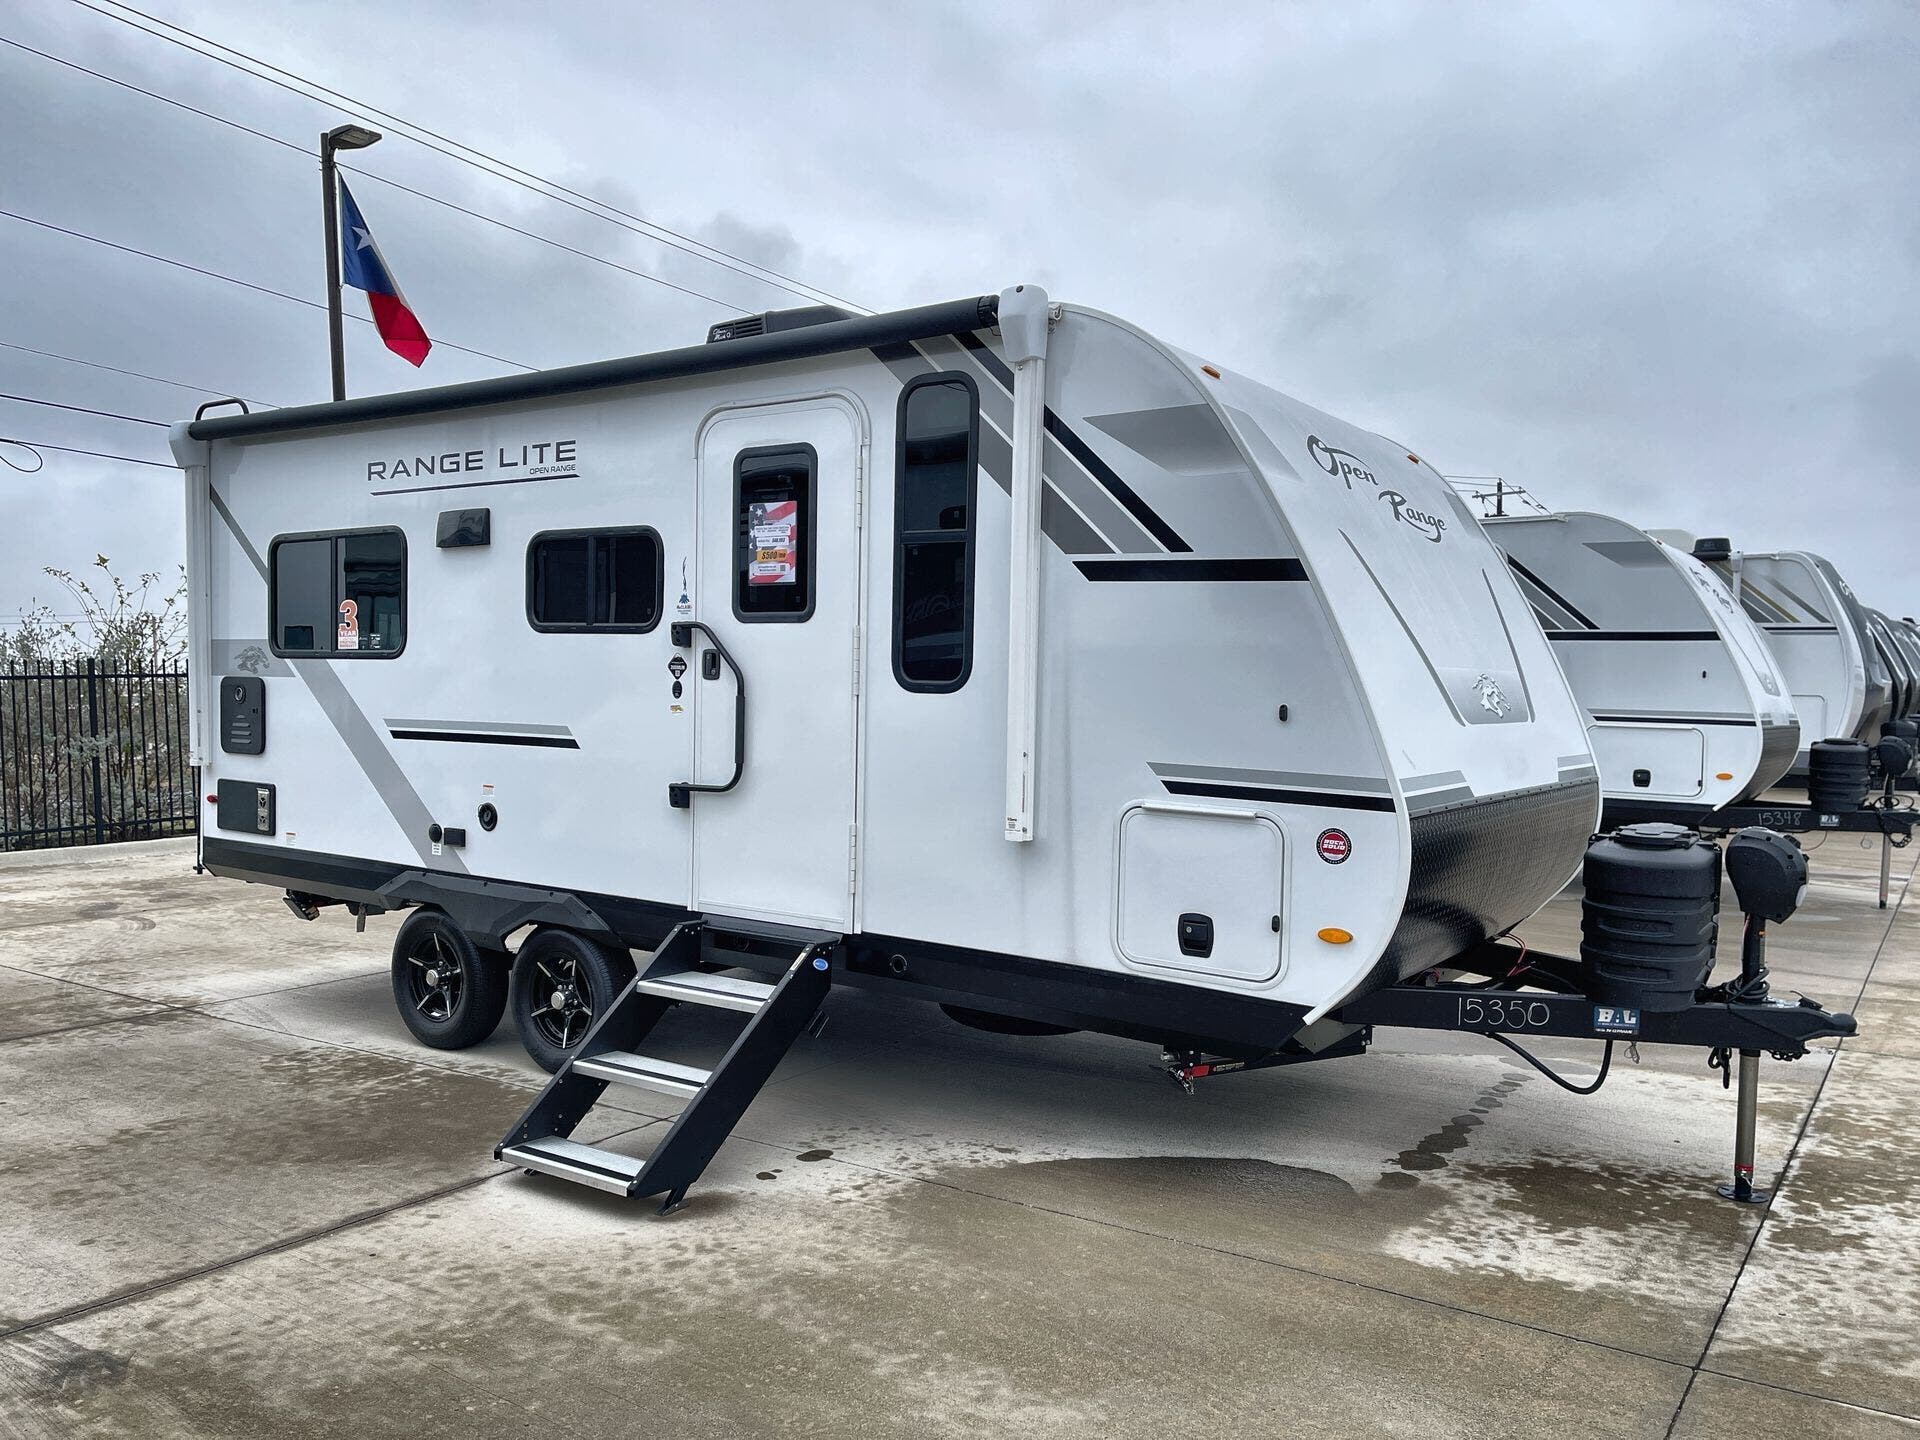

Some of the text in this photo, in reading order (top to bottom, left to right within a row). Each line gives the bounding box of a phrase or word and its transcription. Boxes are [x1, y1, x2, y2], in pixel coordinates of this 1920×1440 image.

[367, 439, 577, 482] RANGE LITE
[529, 463, 577, 475] OPEN RANGE
[1306, 434, 1379, 490] Open
[1378, 490, 1447, 544] Range
[339, 599, 358, 630] 3
[1758, 811, 1802, 826] 15348
[1323, 838, 1345, 846] ROCK
[1457, 997, 1550, 1029] 15350
[1597, 1008, 1637, 1024] BAL
